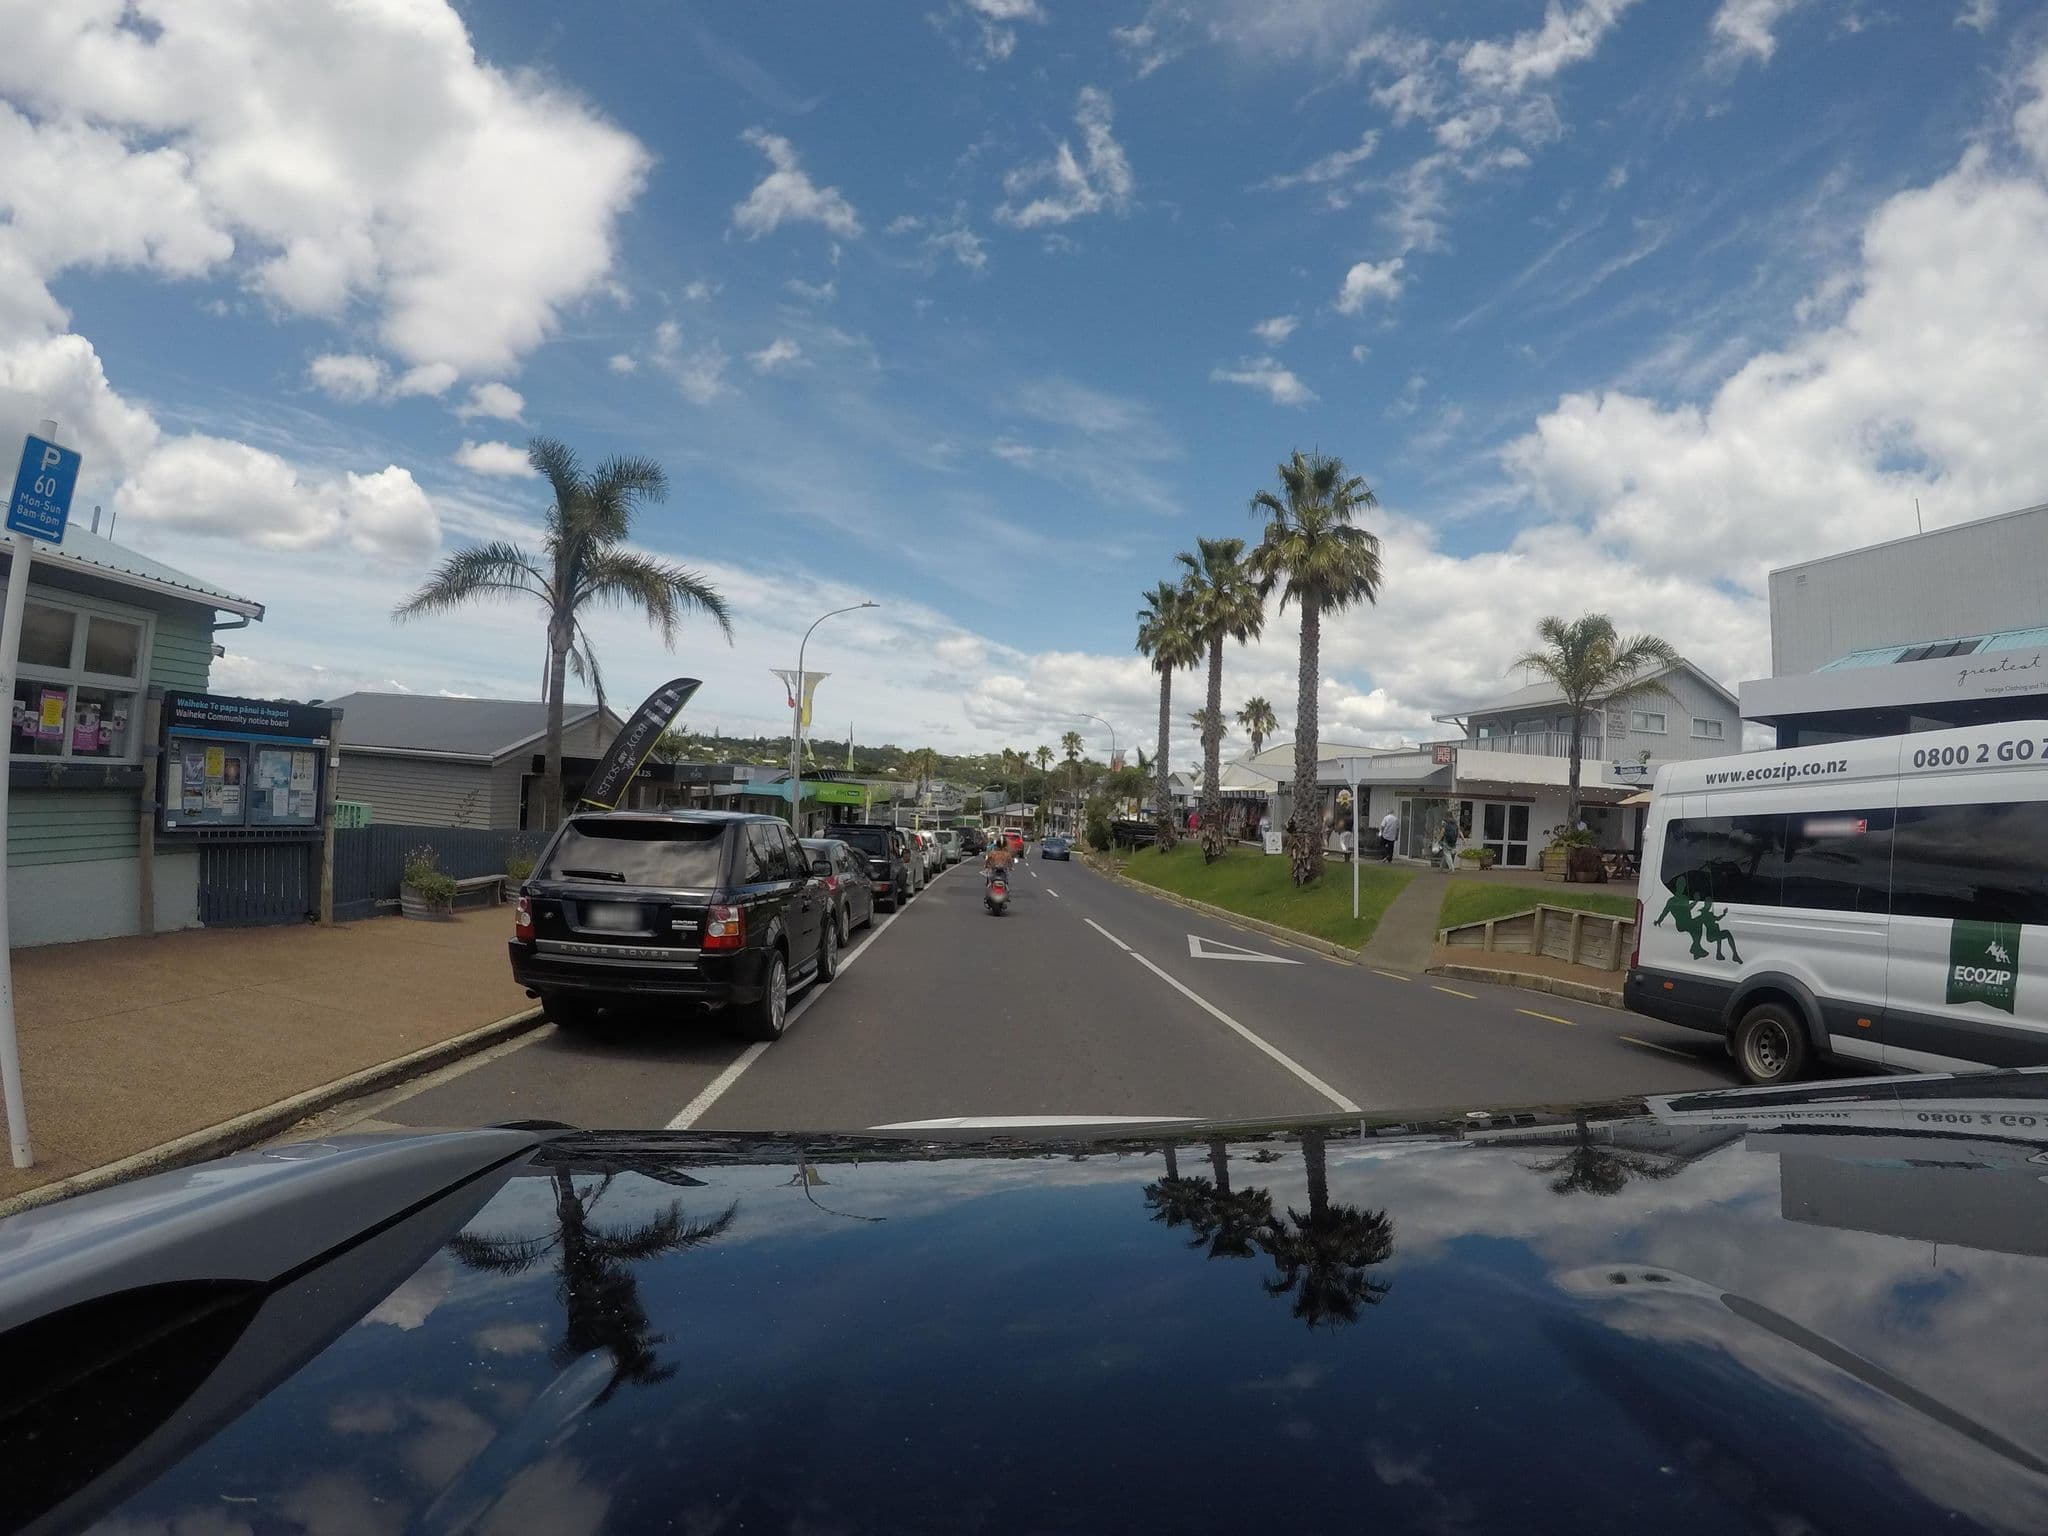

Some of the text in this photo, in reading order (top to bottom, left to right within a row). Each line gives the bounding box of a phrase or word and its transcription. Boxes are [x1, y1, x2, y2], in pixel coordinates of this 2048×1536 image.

[41, 446, 61, 471] P
[34, 475, 56, 497] 60
[20, 492, 61, 514] Mon-Sun
[17, 505, 60, 525] 8am-6pm
[1958, 653, 2041, 687] greatest
[177, 698, 209, 709] Waiheke
[210, 702, 219, 710] Te
[220, 704, 238, 713] papa
[176, 709, 290, 728] Waiheke Community notice board
[1705, 759, 1847, 785] www.ecozip.co.nz
[1913, 746, 1969, 768] 0800
[1975, 743, 1990, 763] 2
[1997, 739, 2034, 761] GO
[597, 764, 621, 797] SOLES
[560, 944, 670, 957] RANGE ROVER
[1954, 965, 2011, 985] ECOZIP
